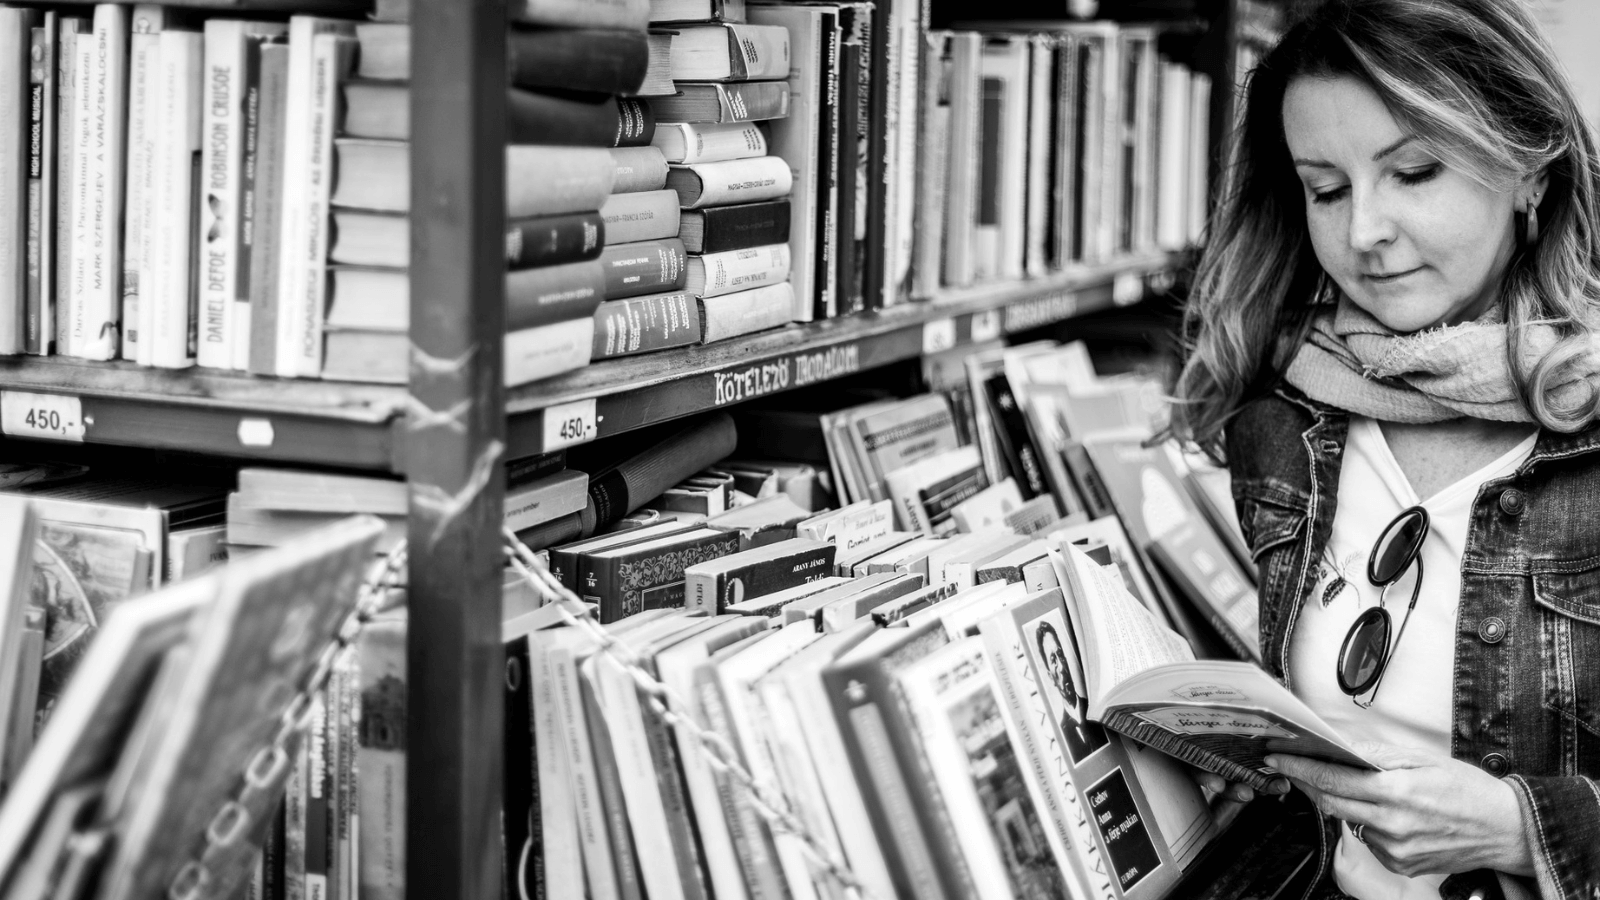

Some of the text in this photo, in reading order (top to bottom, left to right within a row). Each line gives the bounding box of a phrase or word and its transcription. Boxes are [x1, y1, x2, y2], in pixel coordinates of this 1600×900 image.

[31, 86, 41, 177] HIGH SCHOOL MUSICAL
[207, 65, 231, 343] DANIEL DEFOE ROBINSON CRUSOE
[94, 253, 103, 290] MARK
[795, 344, 859, 387] IRODALOM
[25, 408, 75, 434] 450,-
[559, 415, 592, 441] 450,-
[792, 557, 826, 573] ARANY JÁNOS
[1017, 718, 1037, 755] NYAKÁN
[1175, 719, 1223, 727] Sárga
[1044, 786, 1059, 813] ANNA
[1090, 789, 1109, 808] Csehov
[1098, 810, 1113, 826] Anna
[1108, 824, 1122, 841] férje
[1120, 812, 1139, 834] nyakán
[1055, 816, 1074, 851] CSEHOV
[1120, 866, 1140, 885] EURÓPA
